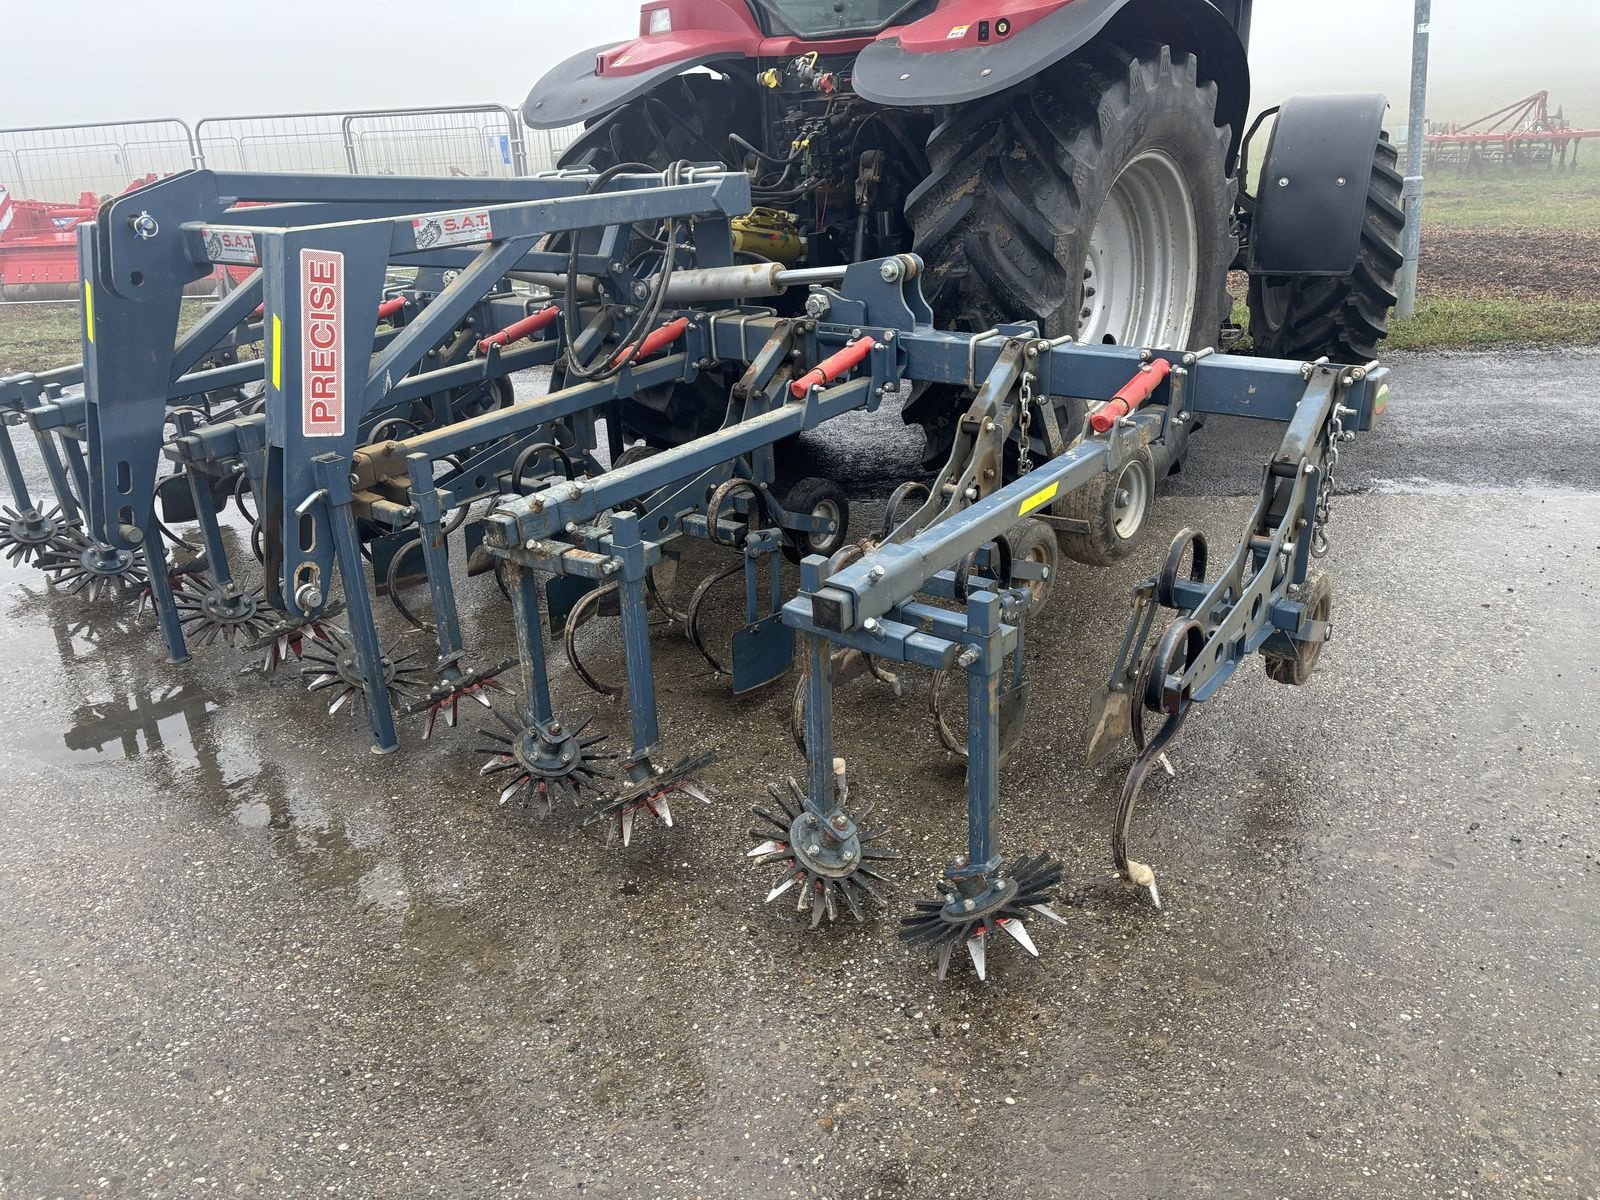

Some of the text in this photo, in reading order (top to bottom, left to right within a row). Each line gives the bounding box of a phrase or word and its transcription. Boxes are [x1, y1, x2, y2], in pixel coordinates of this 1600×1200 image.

[443, 213, 488, 231] S.A.T.
[222, 234, 254, 248] S.A.T.
[309, 260, 336, 423] PRECISE
